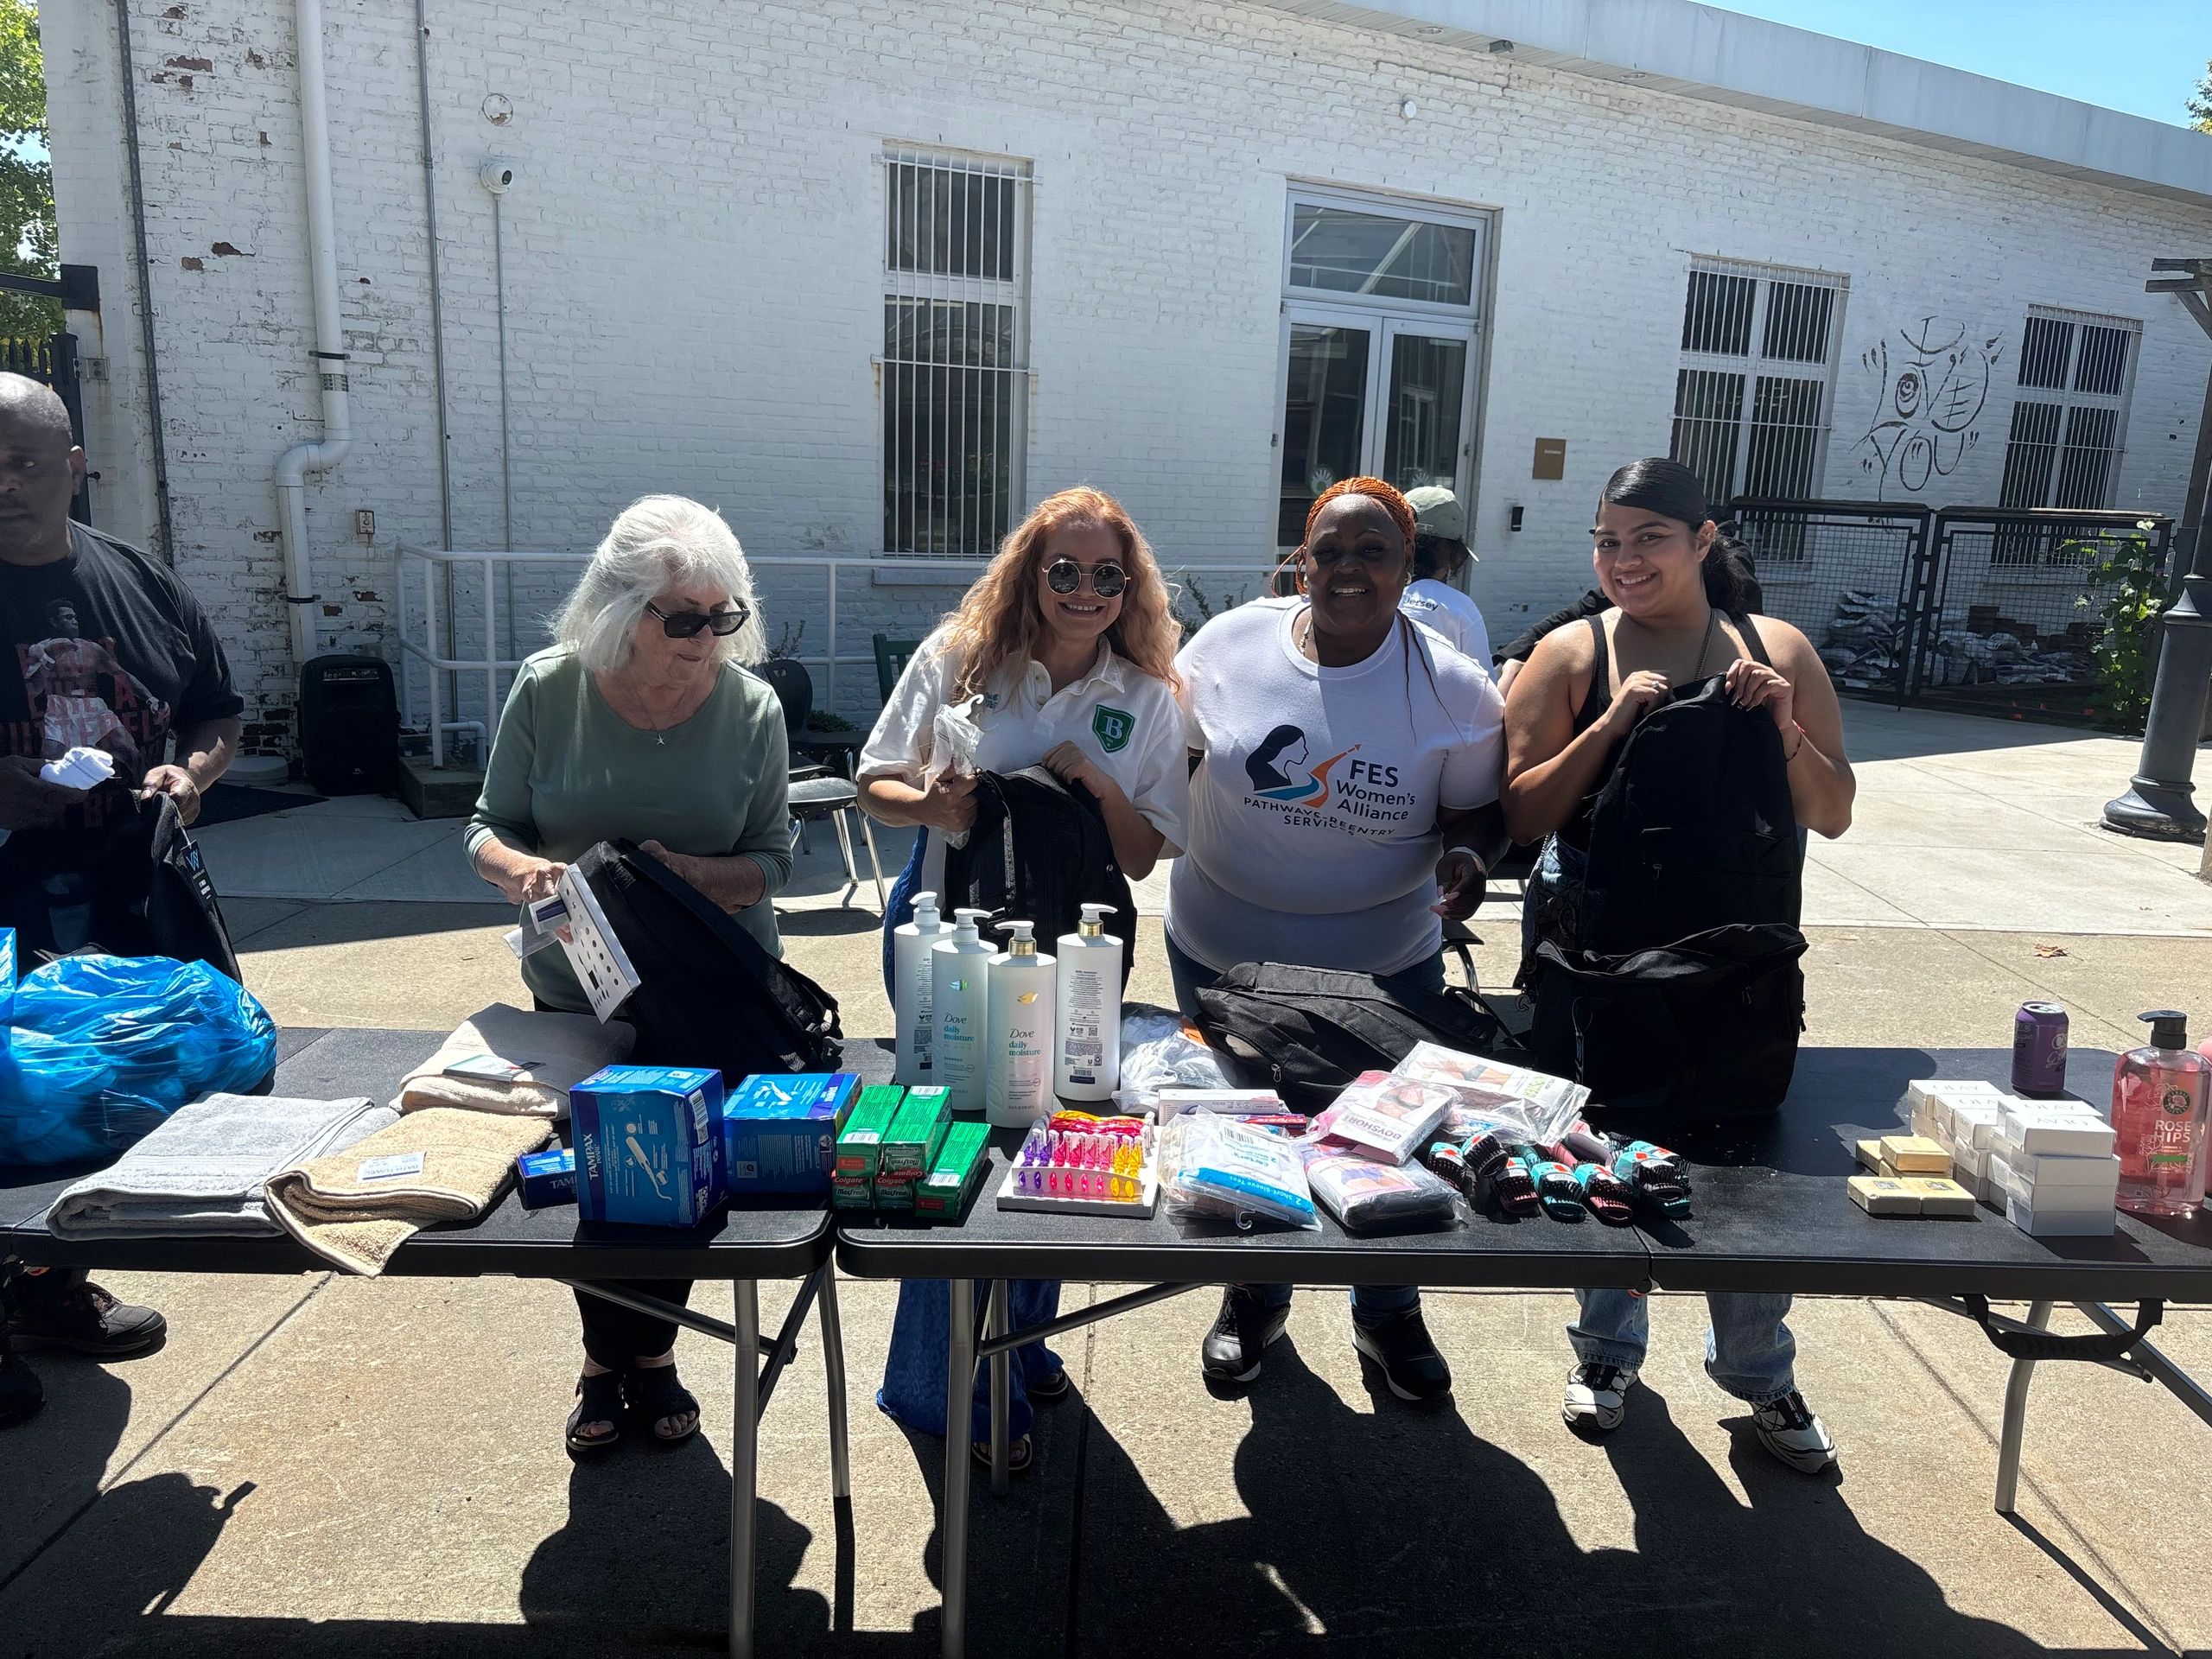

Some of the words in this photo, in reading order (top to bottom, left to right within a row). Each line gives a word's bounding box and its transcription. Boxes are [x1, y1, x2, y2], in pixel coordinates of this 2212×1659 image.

[1870, 429, 1966, 502] YOU
[1403, 598, 1440, 611] Jersey
[1103, 715, 1124, 740] B
[1349, 759, 1399, 788] FES
[1336, 779, 1416, 806] Women's
[1337, 798, 1409, 822] Alliance
[944, 1012, 967, 1024] Dove
[944, 1025, 961, 1035] daily
[1009, 1028, 1035, 1039] Dove
[944, 1033, 975, 1042] moisture
[1008, 1040, 1027, 1051] daily
[1342, 1116, 1403, 1141] BOYSHORT
[2155, 1120, 2192, 1132] ROSE
[2153, 1131, 2191, 1143] HIPS
[582, 1133, 600, 1180] TAMPAX
[550, 1176, 577, 1189] TAM
